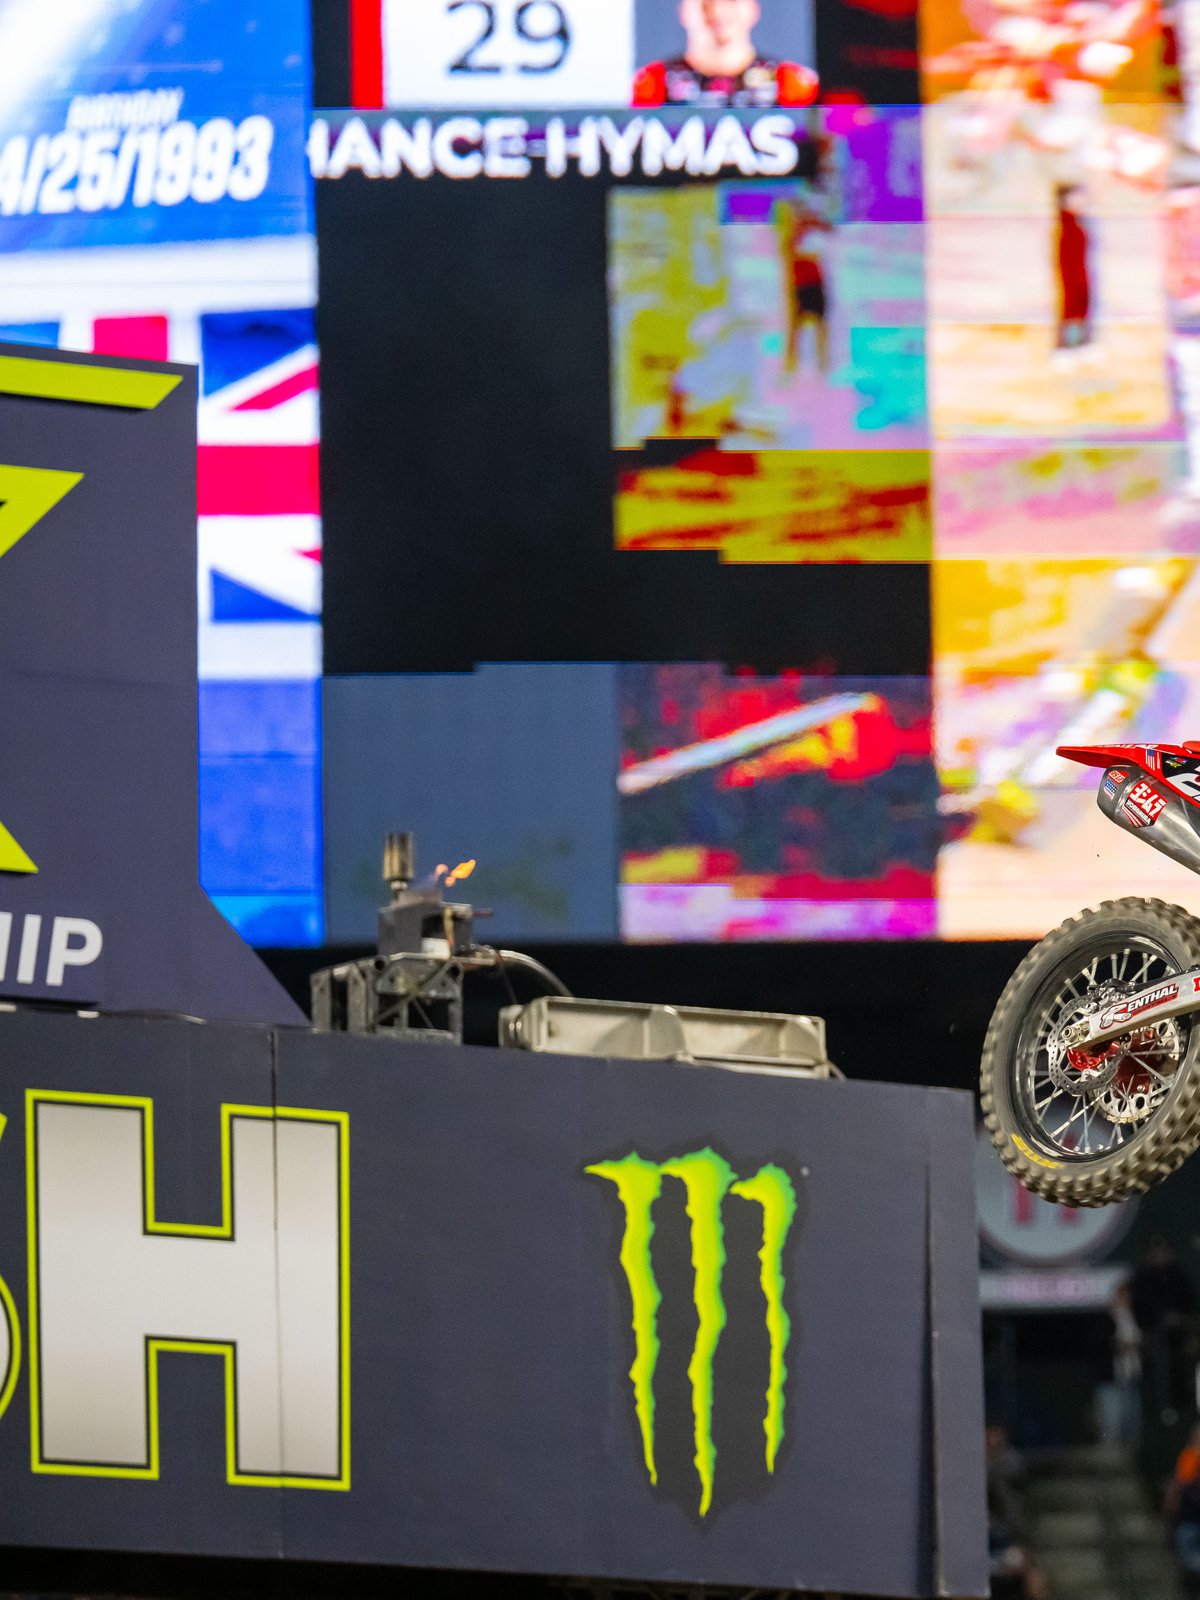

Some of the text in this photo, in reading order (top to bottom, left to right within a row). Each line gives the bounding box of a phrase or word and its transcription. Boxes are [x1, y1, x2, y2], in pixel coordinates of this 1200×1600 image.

[447, 0, 571, 76] 29
[545, 113, 799, 177] HYMAS
[0, 1088, 351, 1491] H
